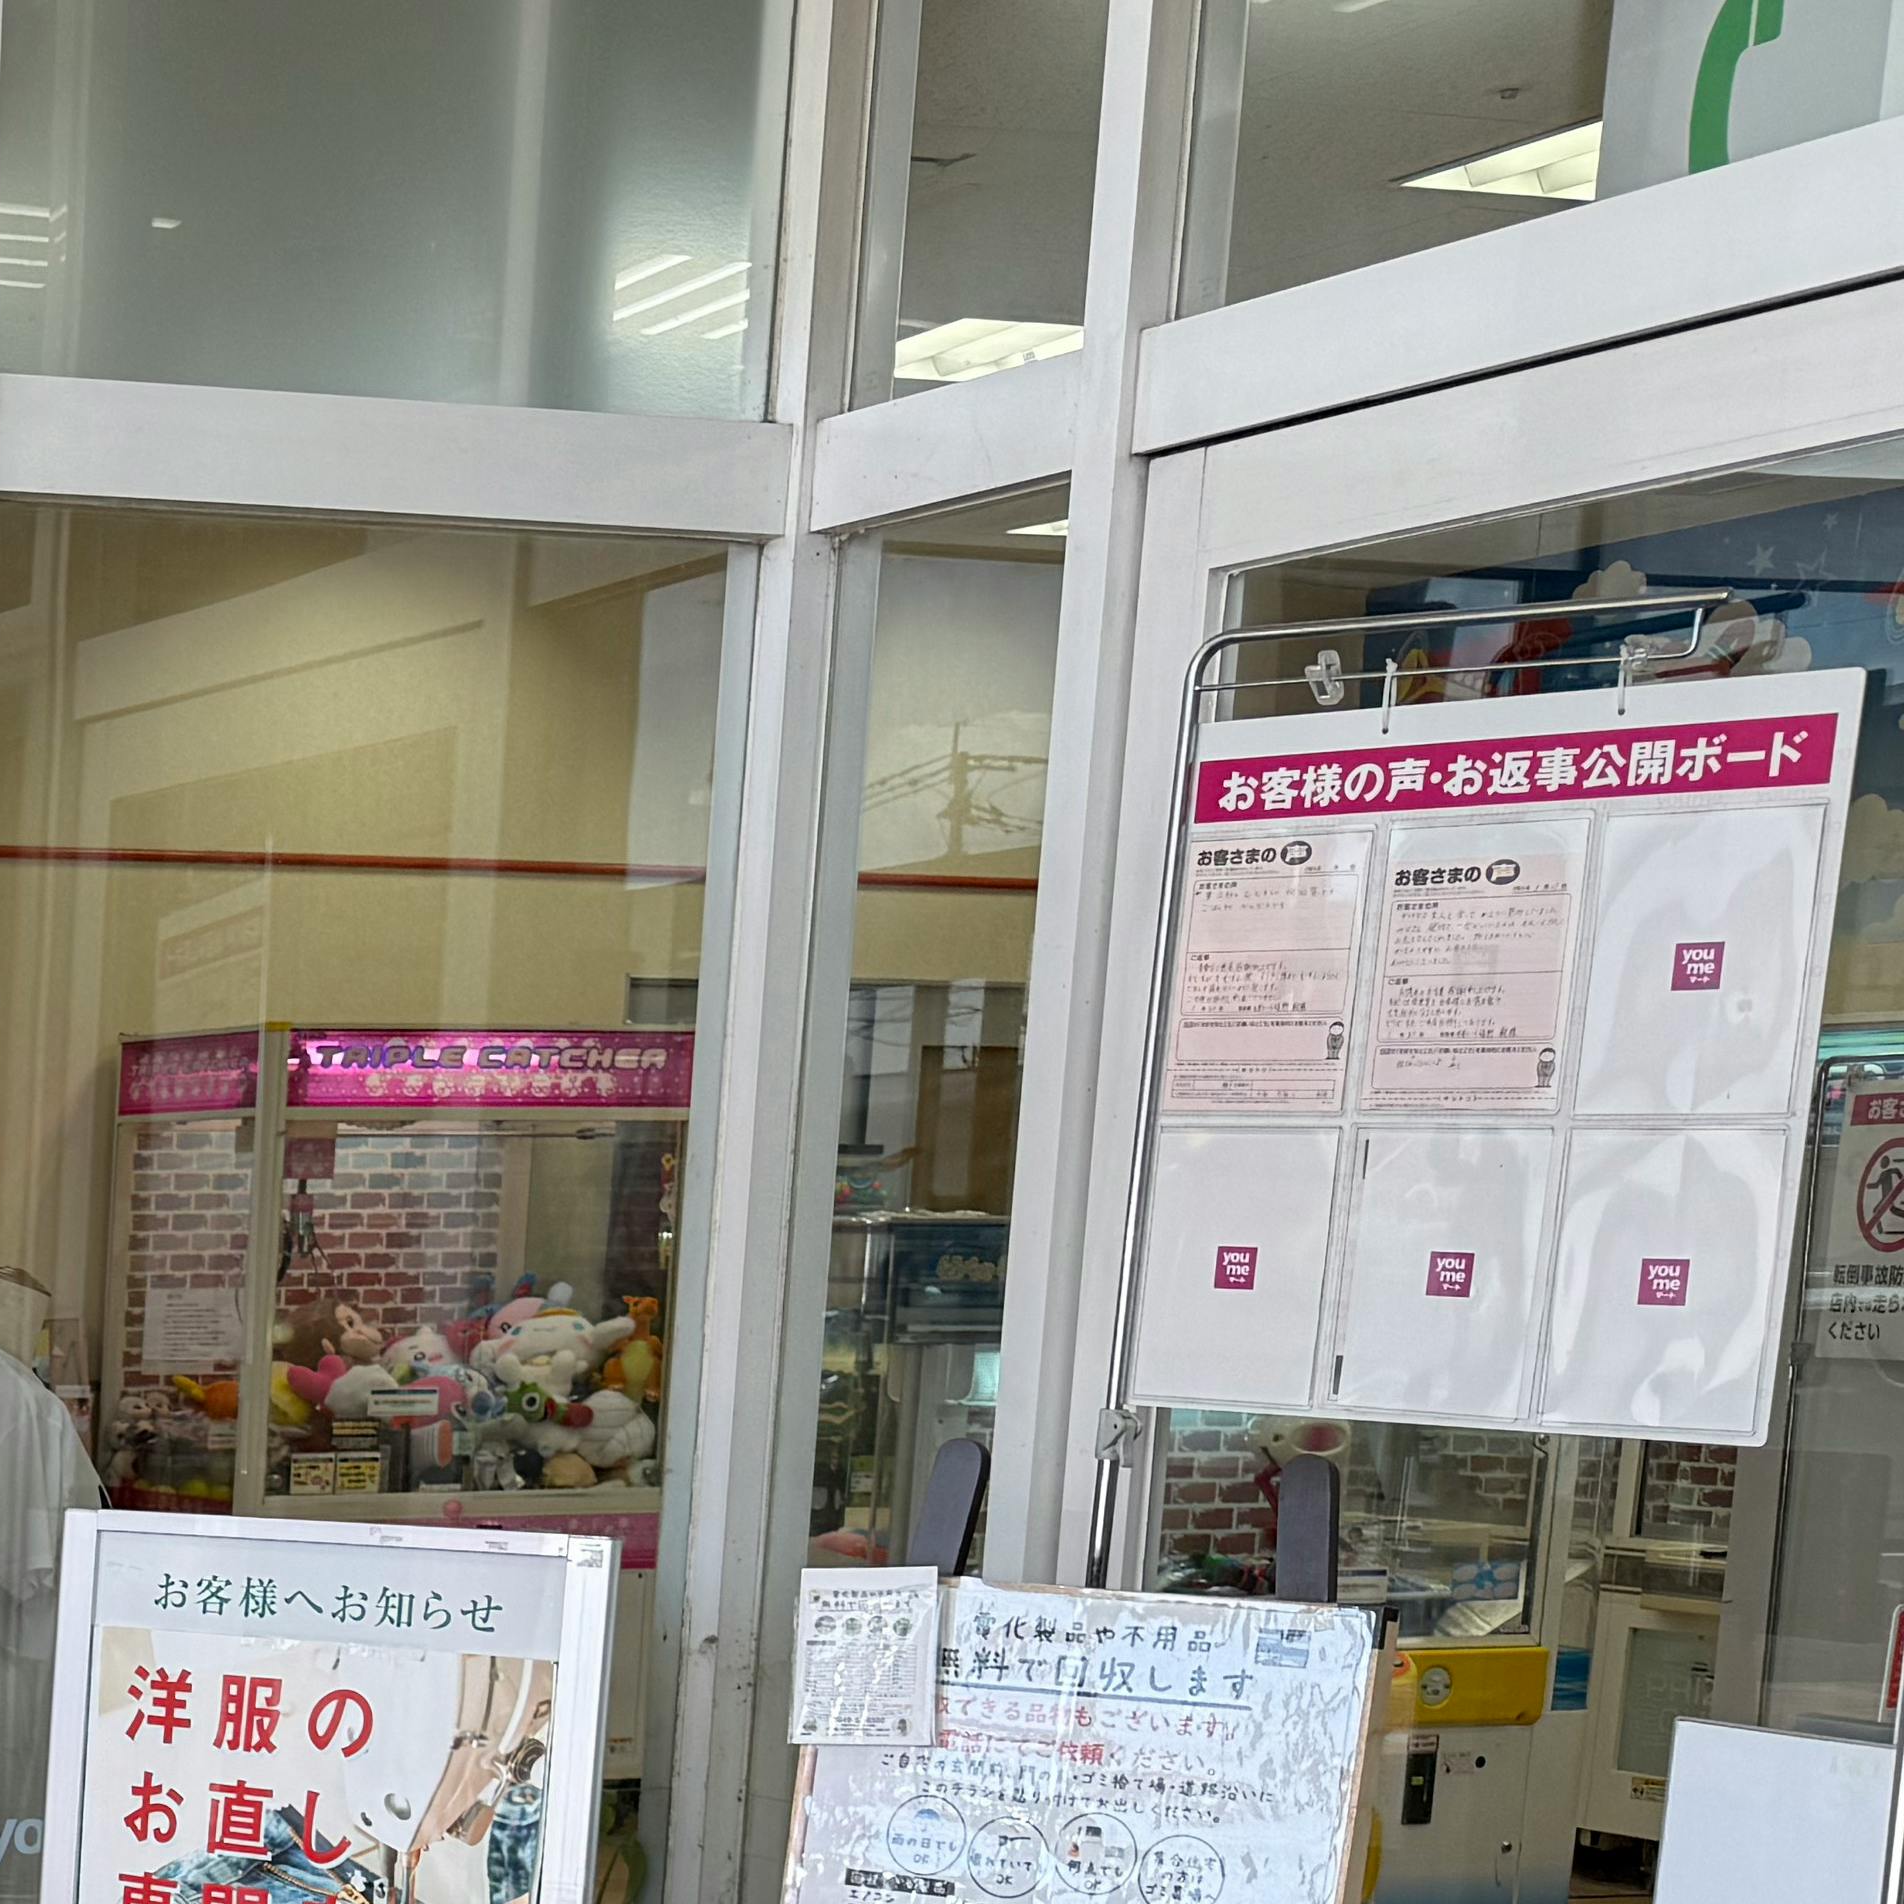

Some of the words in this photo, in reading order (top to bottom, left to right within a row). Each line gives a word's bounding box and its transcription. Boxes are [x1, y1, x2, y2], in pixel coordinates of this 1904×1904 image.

[1218, 729, 1812, 812] お客様の声・お返事公開ボード
[1682, 948, 1715, 965] you
[1686, 962, 1715, 975] me
[317, 1046, 465, 1069] TRIPLE
[478, 1046, 669, 1070] CATCHER
[1222, 1251, 1250, 1266] you
[1436, 1257, 1466, 1272] you
[1226, 1265, 1250, 1276] me
[1439, 1270, 1466, 1283] me
[1648, 1264, 1680, 1280] you
[1652, 1278, 1680, 1291] me
[1828, 1321, 1880, 1341] ください
[154, 1573, 504, 1633] お客様へお知らせ
[126, 1664, 375, 1760] 洋服の
[124, 1772, 352, 1868] お直し
